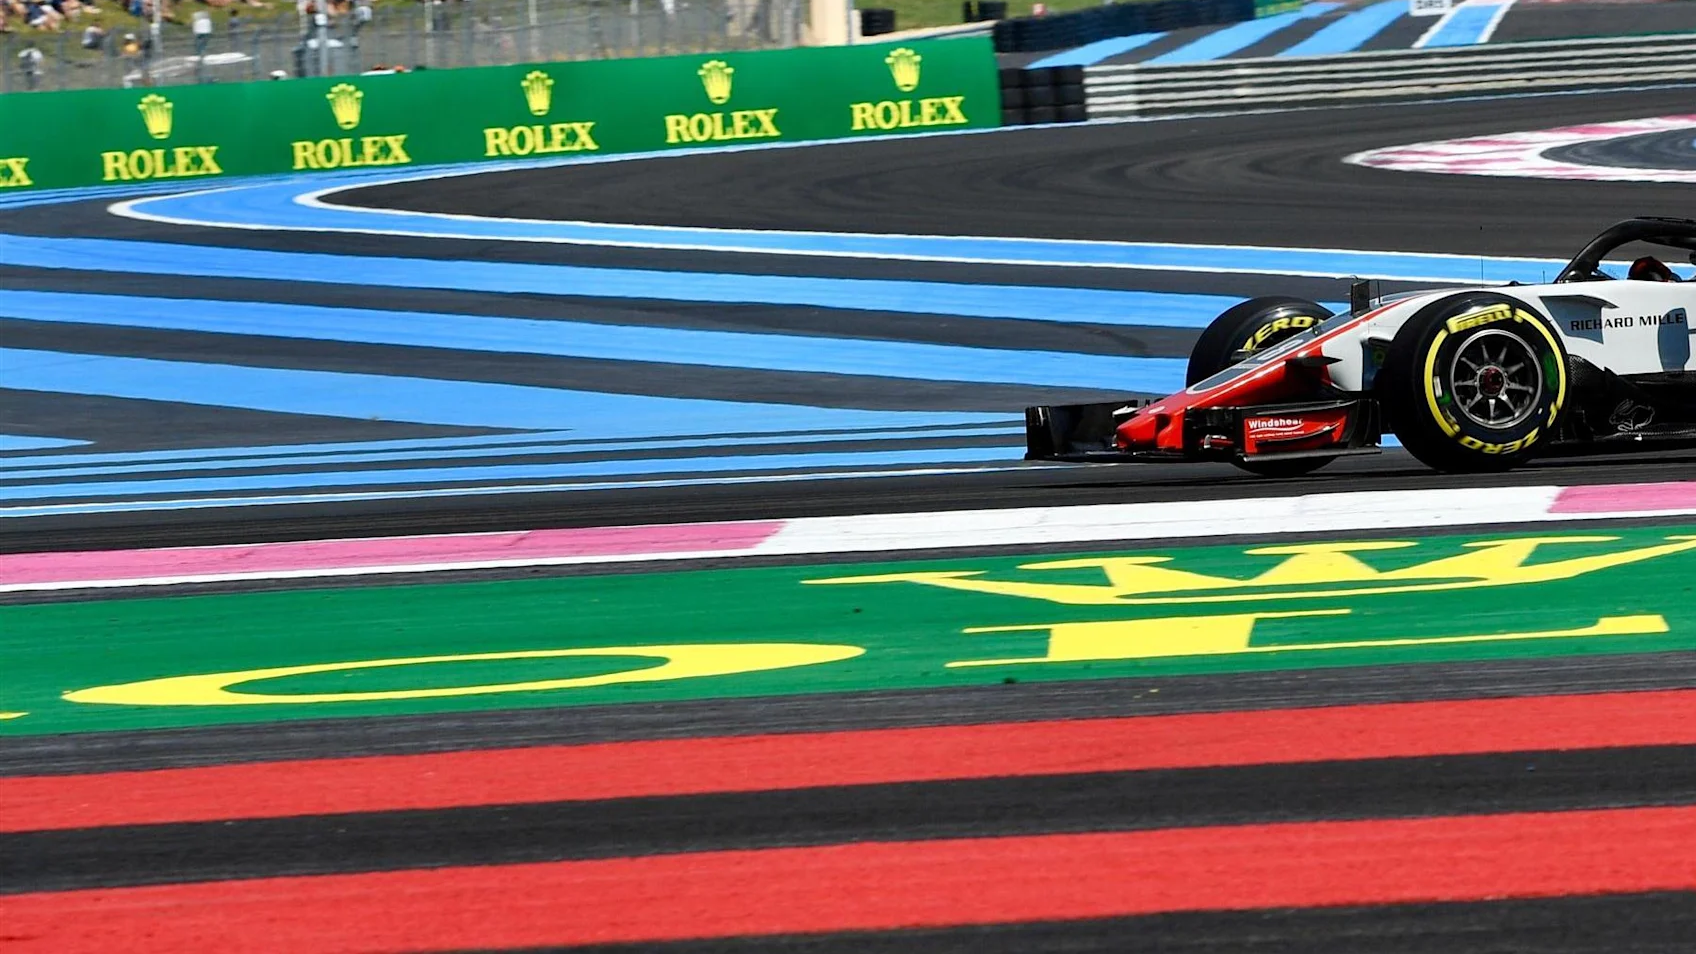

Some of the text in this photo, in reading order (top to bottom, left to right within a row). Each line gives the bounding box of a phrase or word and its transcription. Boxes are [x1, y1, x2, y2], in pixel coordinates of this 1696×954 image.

[664, 108, 781, 143] ROLEX
[850, 96, 968, 131] ROLEX
[291, 134, 411, 170] ROLEX
[483, 122, 599, 156] ROLEX
[101, 146, 223, 181] ROLEX
[1570, 312, 1684, 331] RICHARD MILLE
